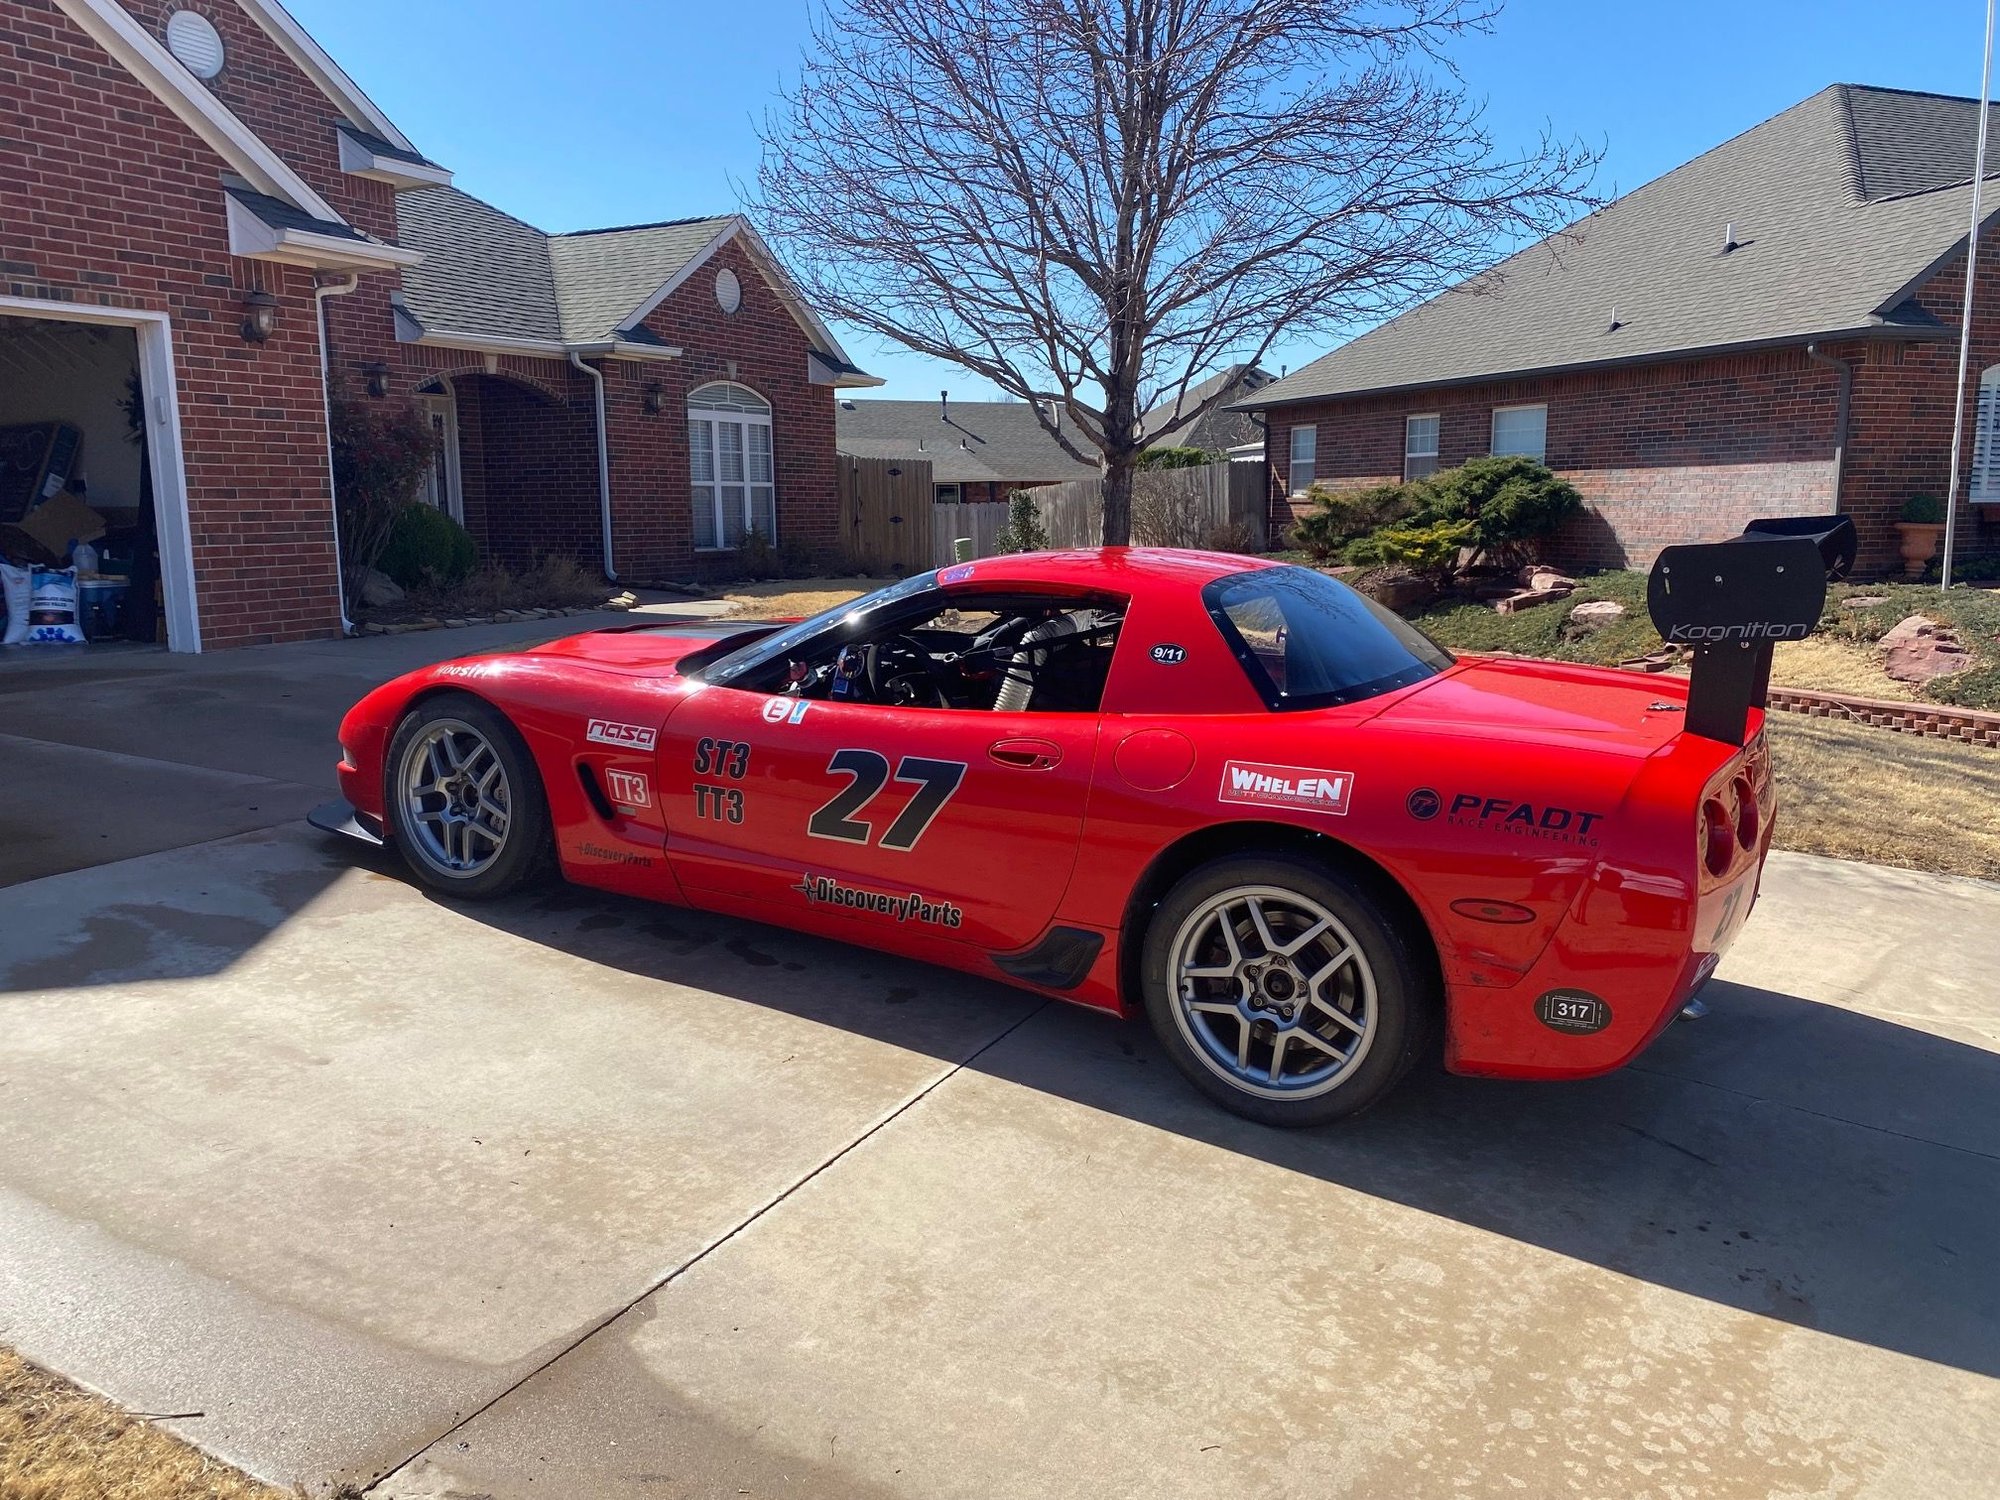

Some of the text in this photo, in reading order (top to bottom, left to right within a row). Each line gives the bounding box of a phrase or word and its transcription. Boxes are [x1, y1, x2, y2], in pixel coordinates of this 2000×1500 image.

[1669, 621, 1808, 642] Kognition
[1153, 647, 1184, 661] 9/11
[588, 721, 656, 744] nasa
[693, 736, 751, 780] ST3
[608, 772, 646, 804] TT3
[1231, 766, 1343, 801] WHELEN
[692, 782, 745, 825] TT3
[807, 748, 968, 852] 27
[1450, 793, 1605, 836] PFADT
[1447, 815, 1599, 847] RACE ENGINEERING
[583, 842, 652, 868] DiscoveryParts
[815, 876, 963, 928] DiscoveryParts
[1557, 1002, 1590, 1019] 317
